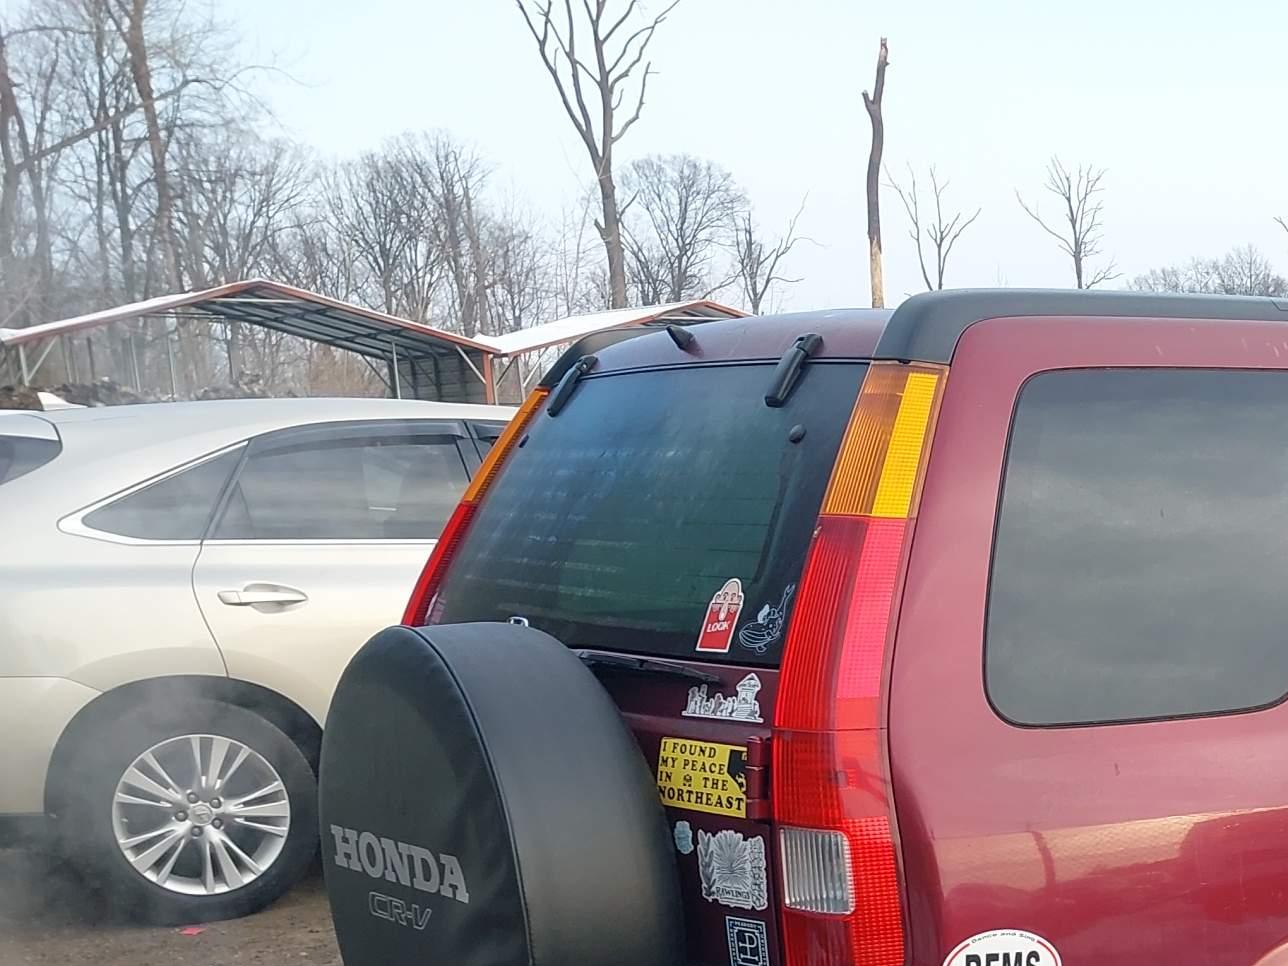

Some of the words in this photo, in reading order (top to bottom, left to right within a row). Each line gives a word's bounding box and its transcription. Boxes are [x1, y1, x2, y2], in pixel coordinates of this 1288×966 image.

[707, 621, 731, 633] LOOK
[662, 741, 667, 752] I
[672, 742, 717, 758] FOUND
[660, 756, 678, 768] MY
[682, 759, 726, 775] PEACE
[659, 771, 672, 782] IN
[702, 777, 729, 791] THE
[658, 785, 744, 811] NORTHEAST
[330, 824, 470, 904] HONDA
[368, 891, 432, 930] CR-V
